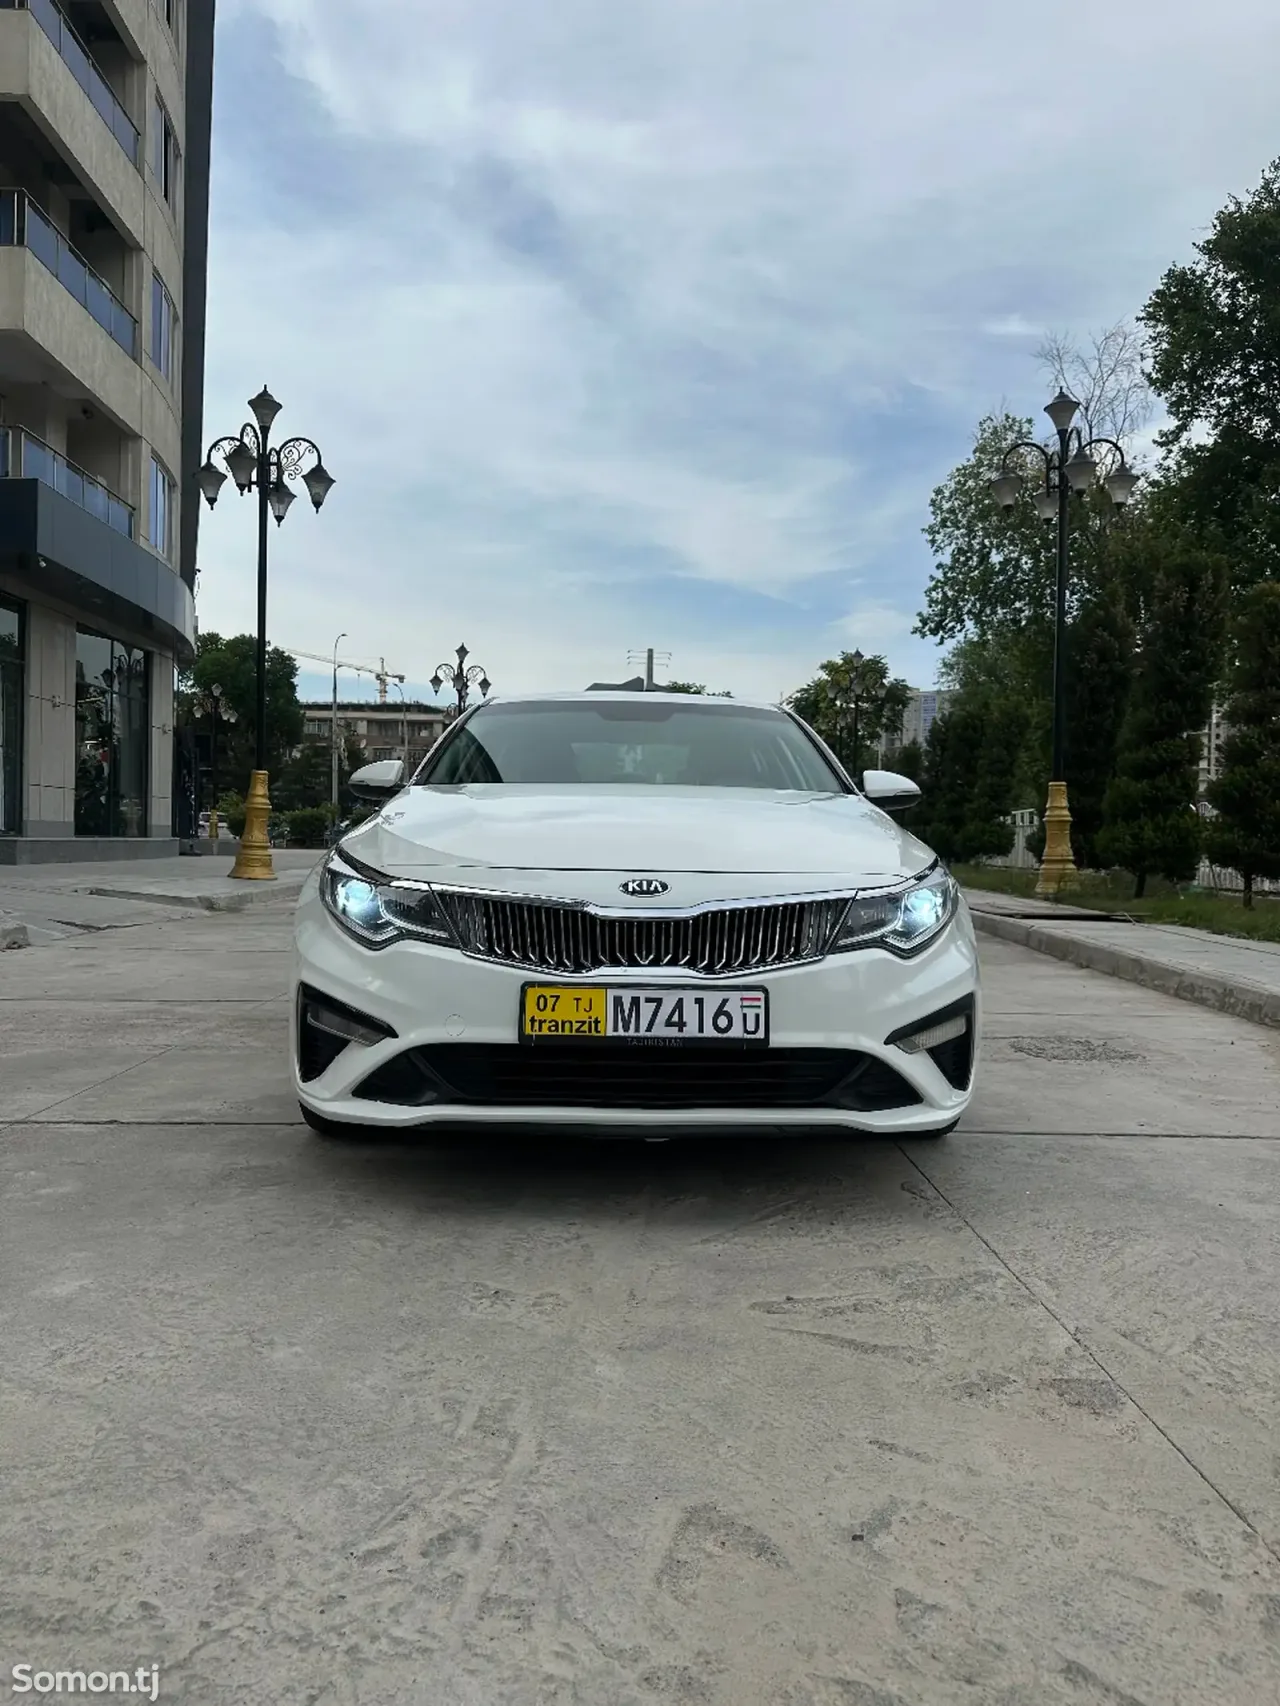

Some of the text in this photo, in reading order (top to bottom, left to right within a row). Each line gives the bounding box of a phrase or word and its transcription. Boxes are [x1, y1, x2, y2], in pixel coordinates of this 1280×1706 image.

[628, 880, 663, 892] KIA
[536, 994, 593, 1013] 07 TJ
[529, 1015, 601, 1034] tranzit
[612, 995, 734, 1035] M7416
